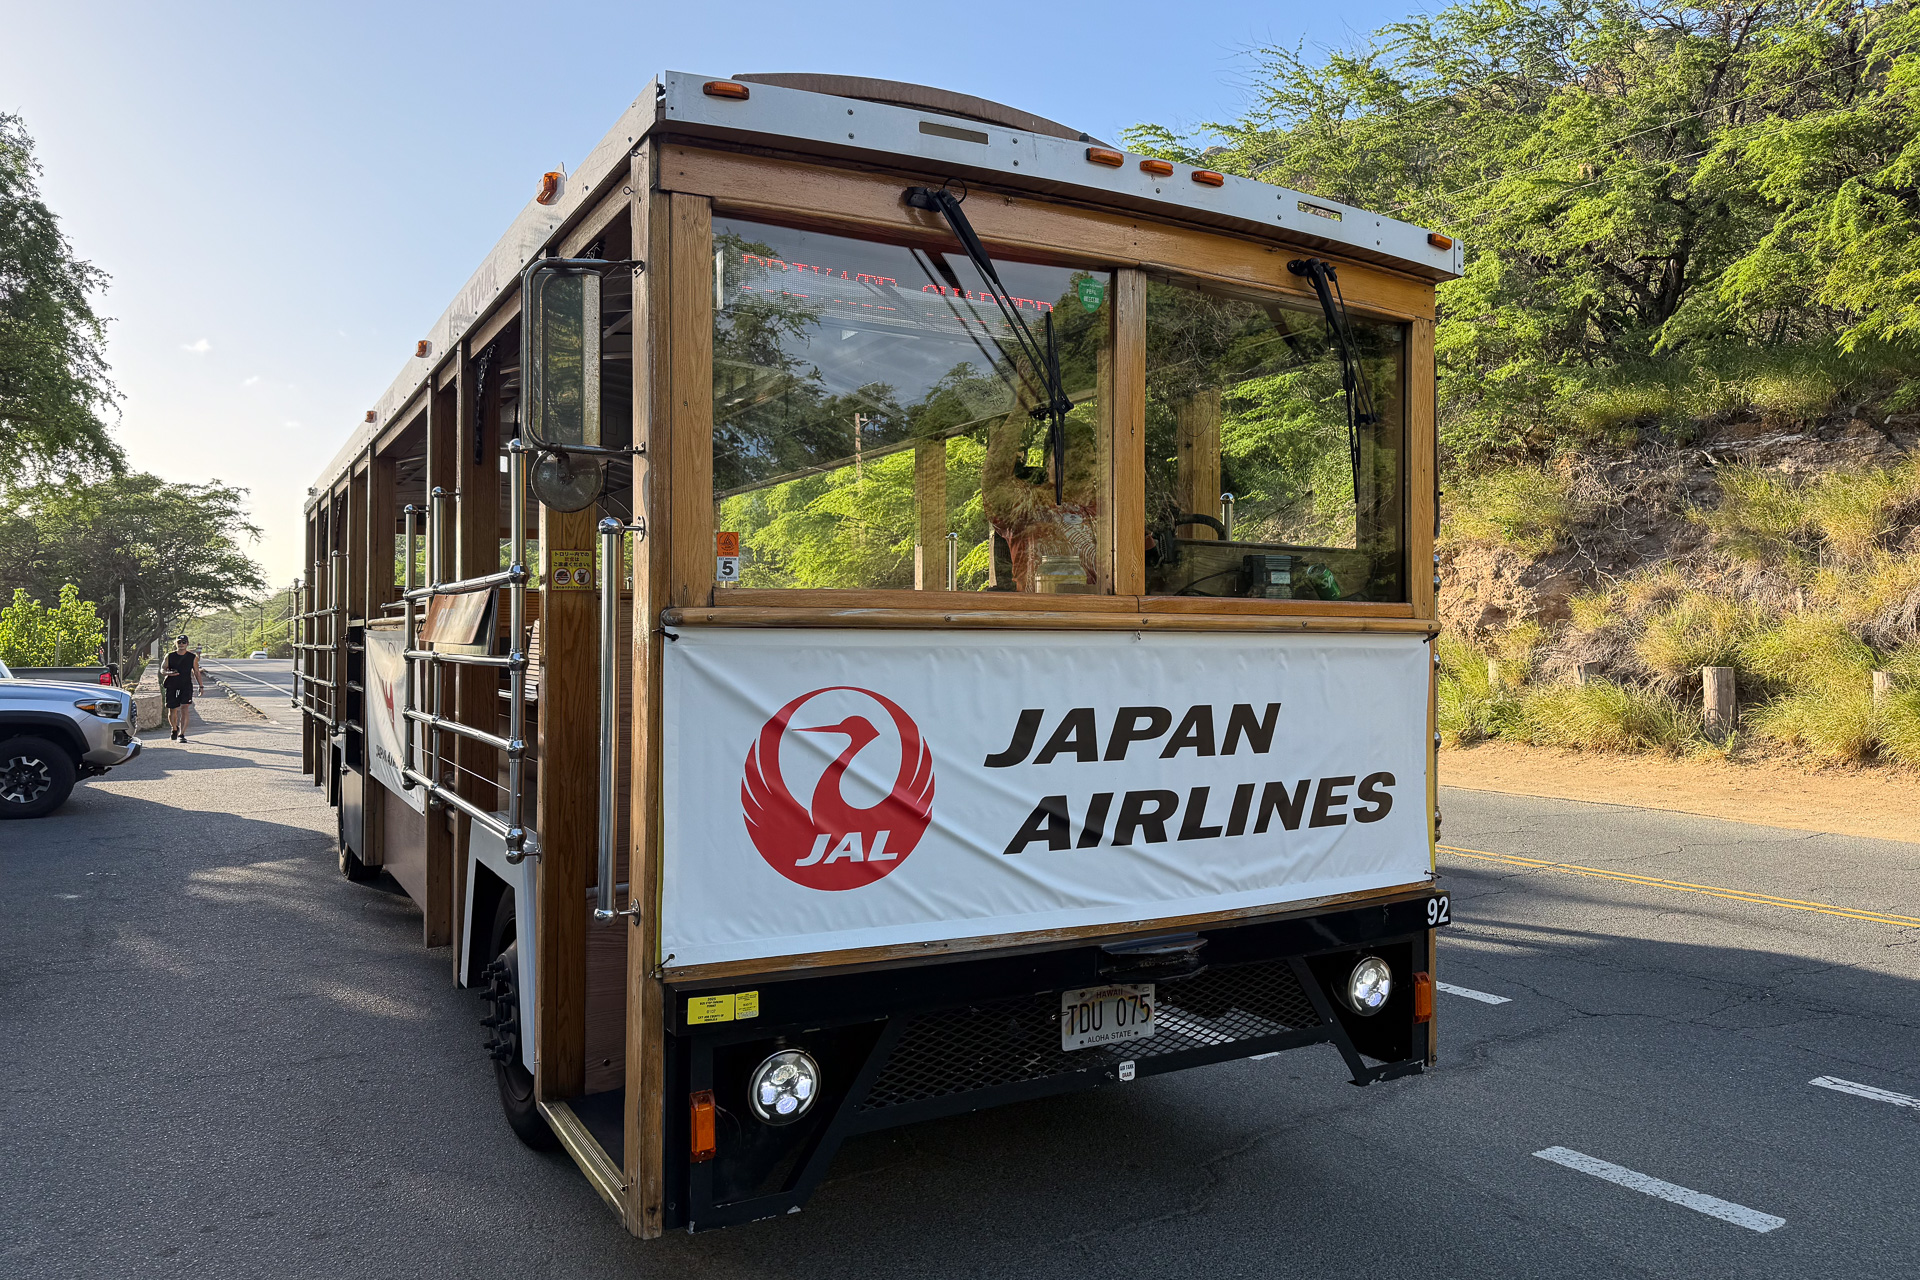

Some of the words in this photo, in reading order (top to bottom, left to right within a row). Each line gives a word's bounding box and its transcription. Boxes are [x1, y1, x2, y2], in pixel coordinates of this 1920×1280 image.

[722, 560, 734, 576] 5
[983, 702, 1281, 769] JAPAN
[1003, 771, 1397, 856] AIRLINES
[794, 830, 899, 868] JAL
[1427, 896, 1449, 926] 92
[1096, 988, 1123, 998] HAWAII
[1067, 1001, 1103, 1035] TDU
[1116, 993, 1150, 1026] 075
[1087, 1033, 1110, 1044] ALOHA
[1111, 1030, 1132, 1039] STATE
